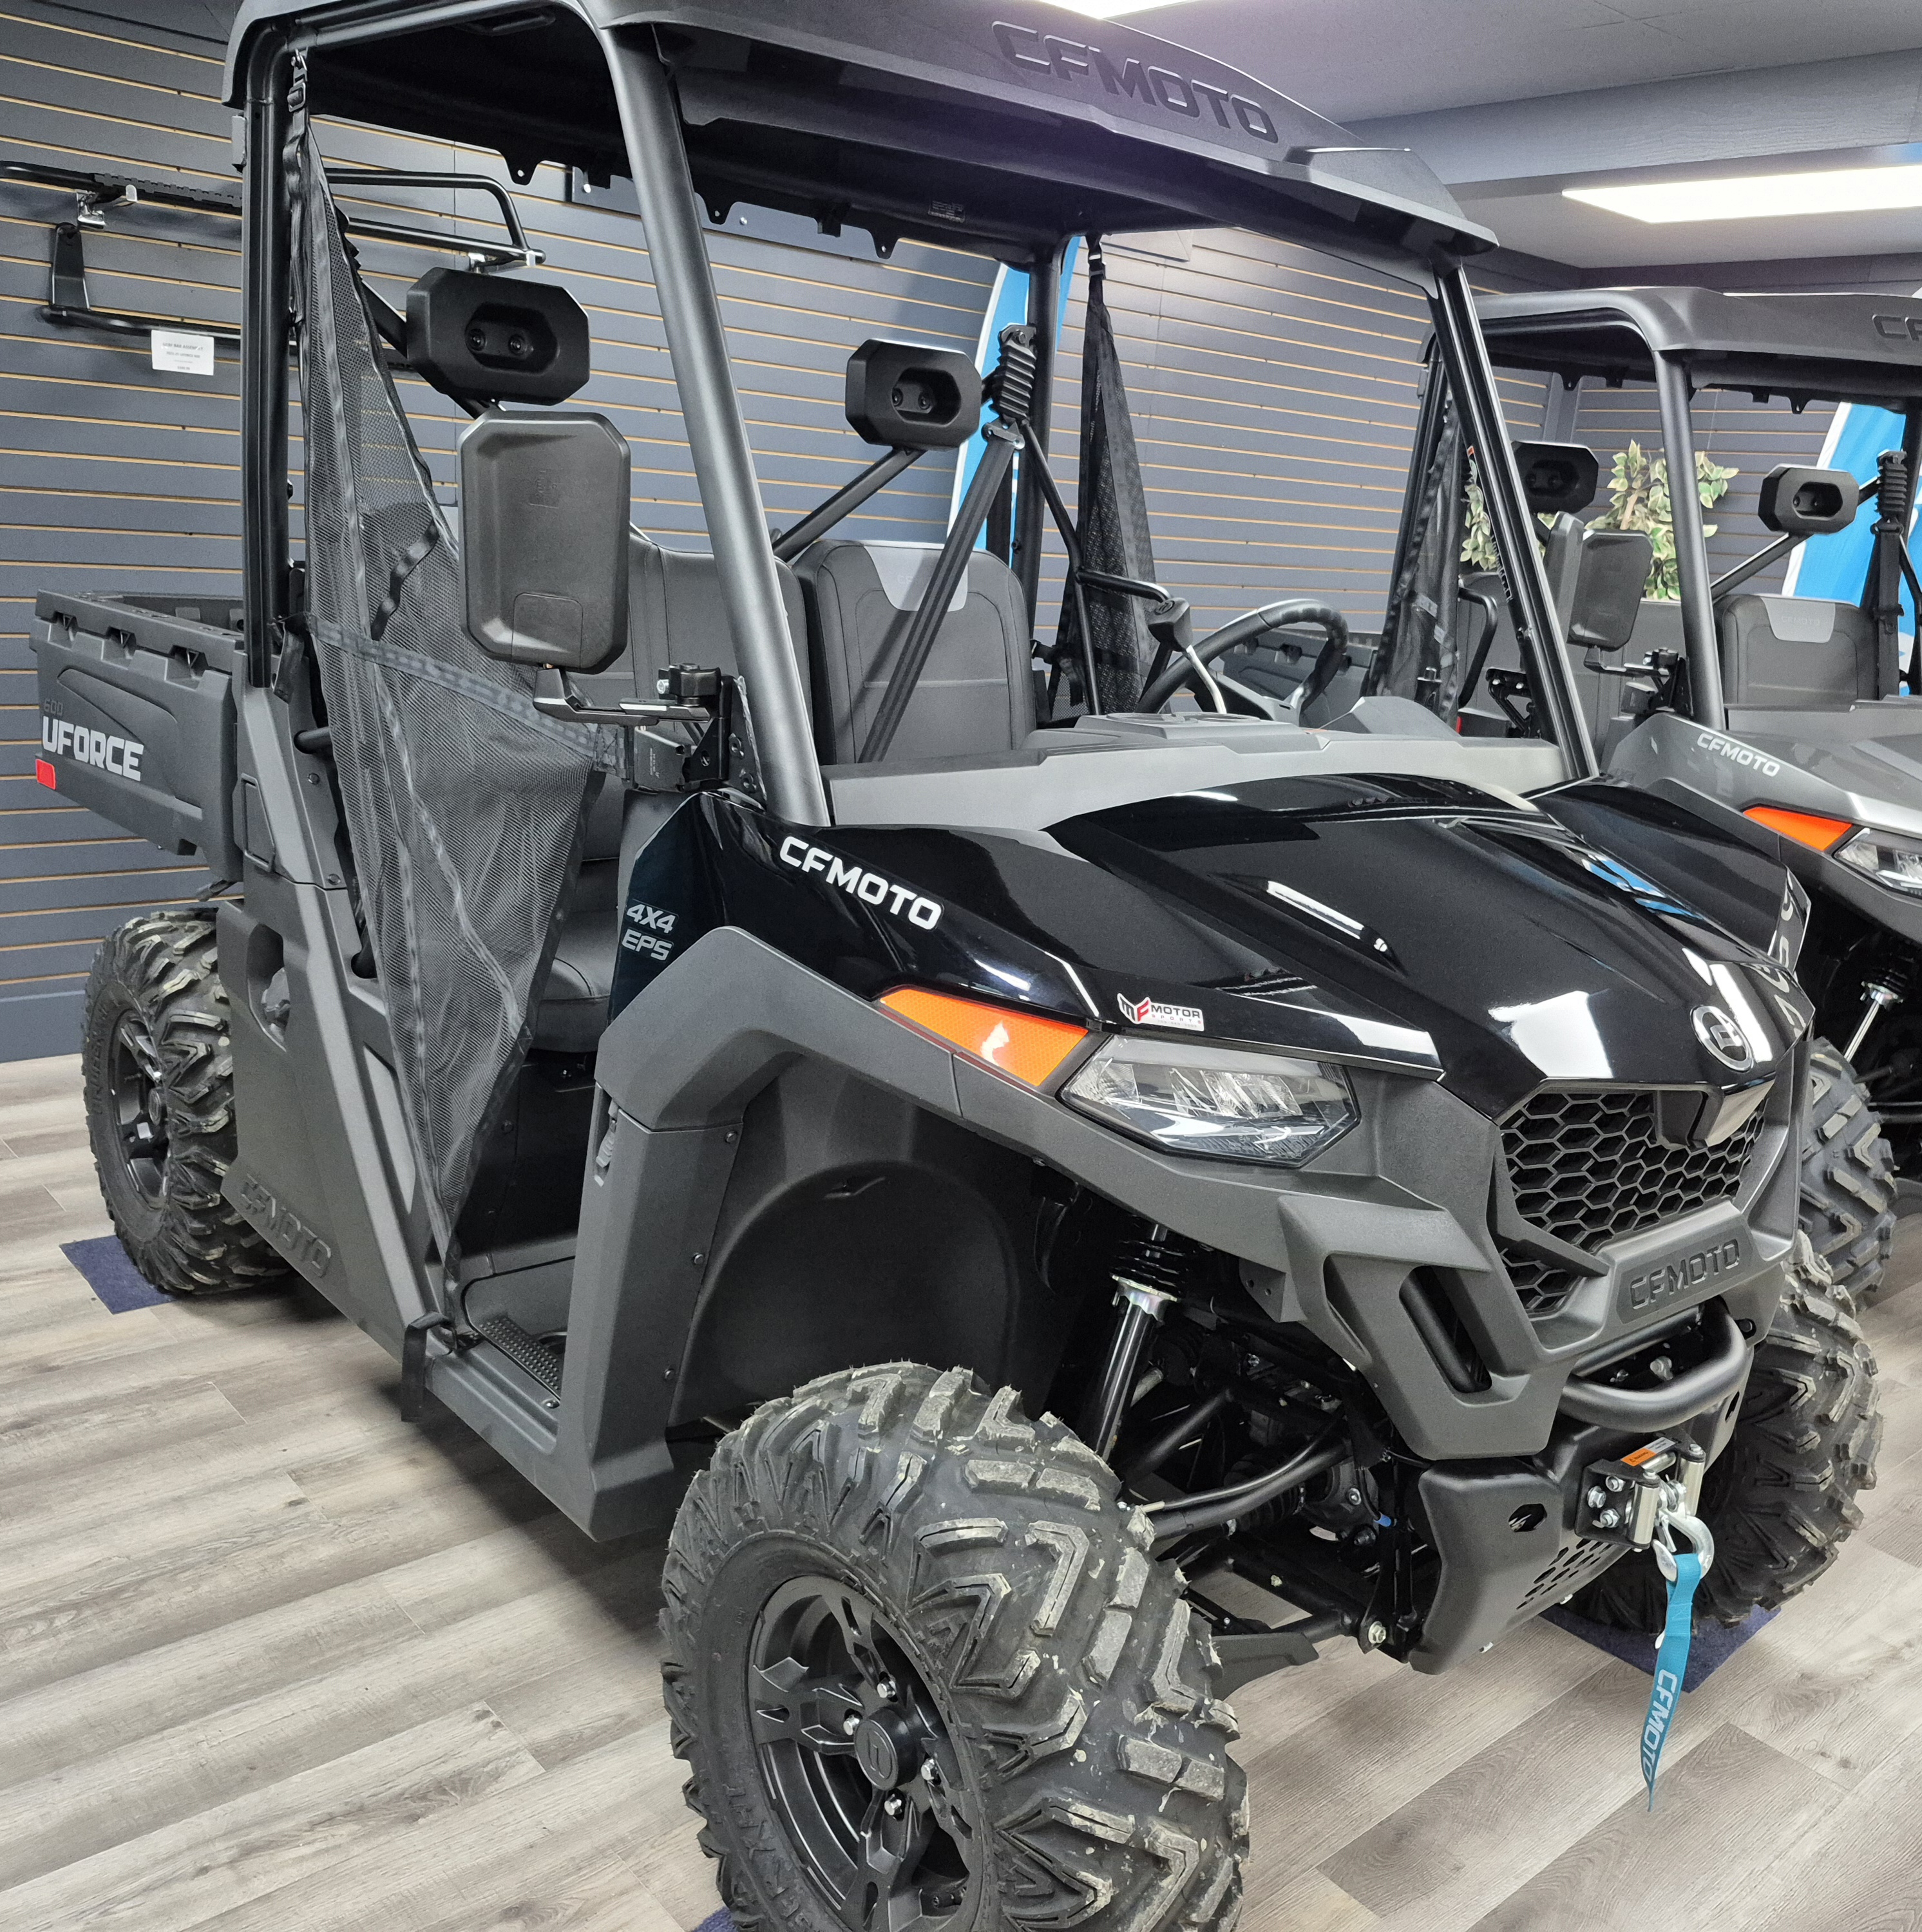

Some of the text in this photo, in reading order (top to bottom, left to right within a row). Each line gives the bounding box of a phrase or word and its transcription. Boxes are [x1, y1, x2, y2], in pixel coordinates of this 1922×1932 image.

[992, 20, 1279, 144] CFMOTO
[44, 697, 63, 716] 600
[42, 715, 144, 782] UFORCE
[1697, 733, 1780, 777] CFMOTO
[779, 836, 942, 930] CFMOTO
[622, 928, 672, 961] EPS
[626, 904, 676, 934] 4X4
[1150, 1005, 1201, 1019] MOTOR
[1152, 1014, 1202, 1025] SPORTS
[240, 1173, 332, 1278] CFMOTO
[1630, 1238, 1740, 1310] CFMOTO
[1642, 1669, 1678, 1783] CFMOTO
